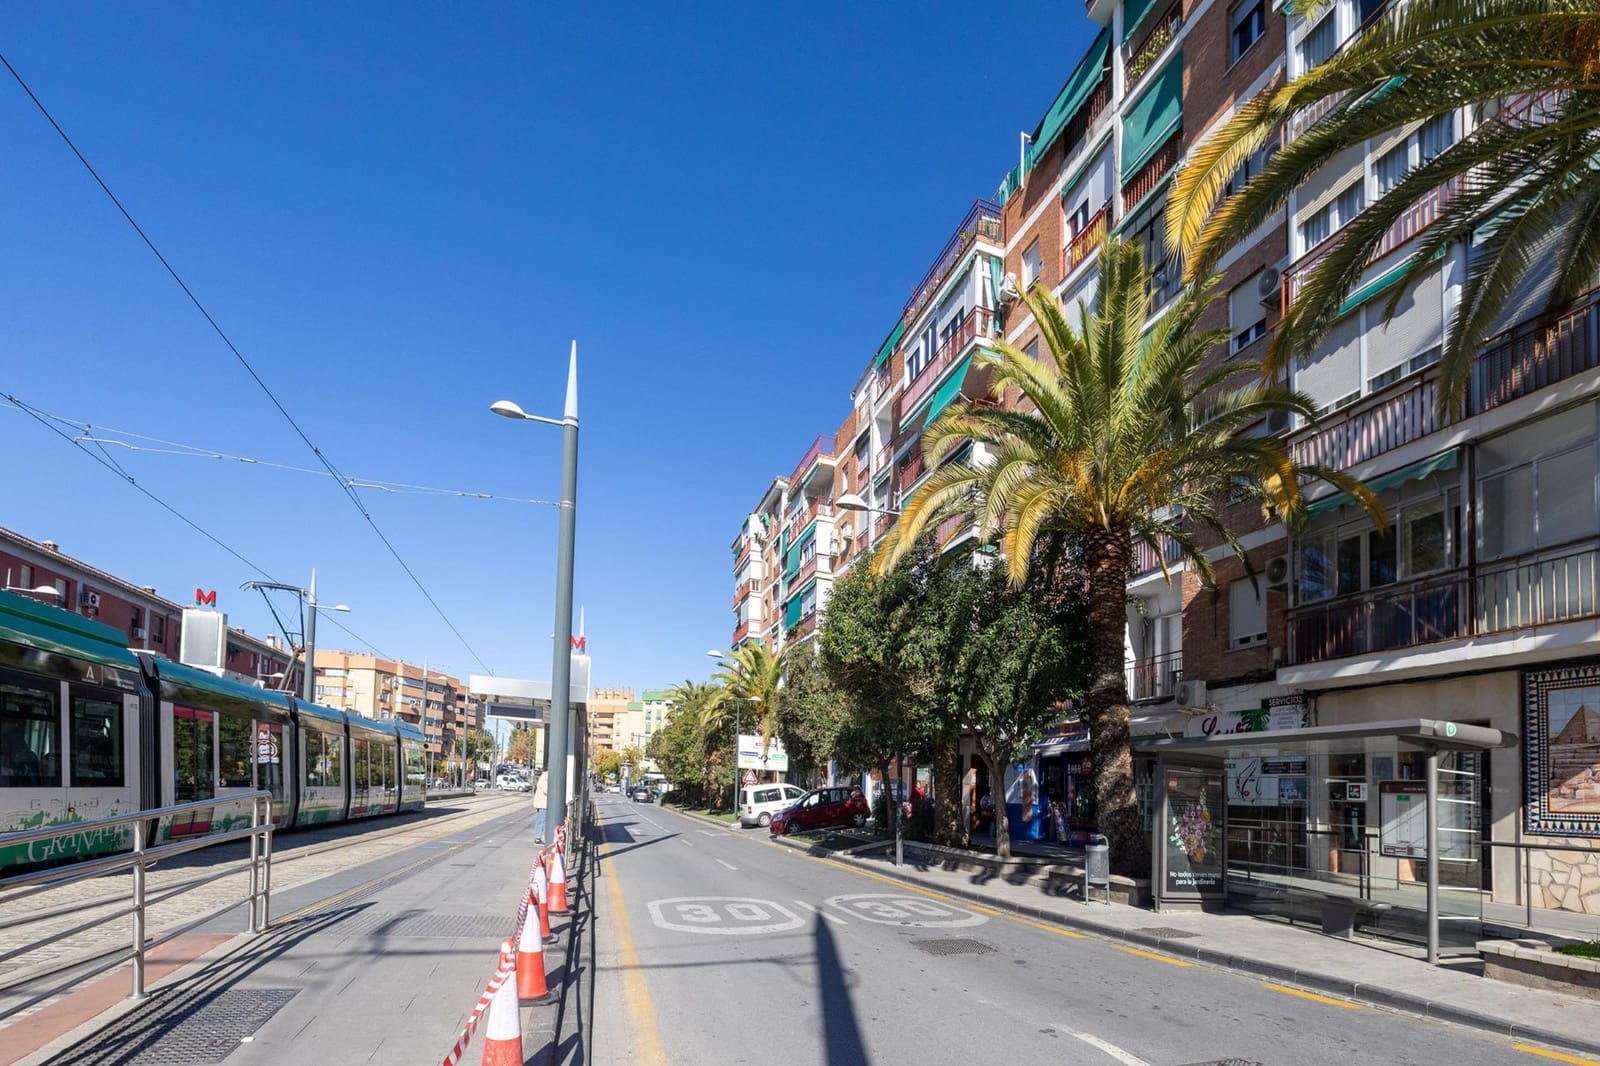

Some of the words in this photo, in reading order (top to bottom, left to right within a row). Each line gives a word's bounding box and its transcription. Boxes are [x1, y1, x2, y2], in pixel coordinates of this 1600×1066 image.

[196, 588, 217, 606] M
[569, 635, 586, 650] M
[1268, 696, 1303, 706] SERVICIOS
[675, 903, 772, 923] 30
[853, 899, 952, 918] 30
